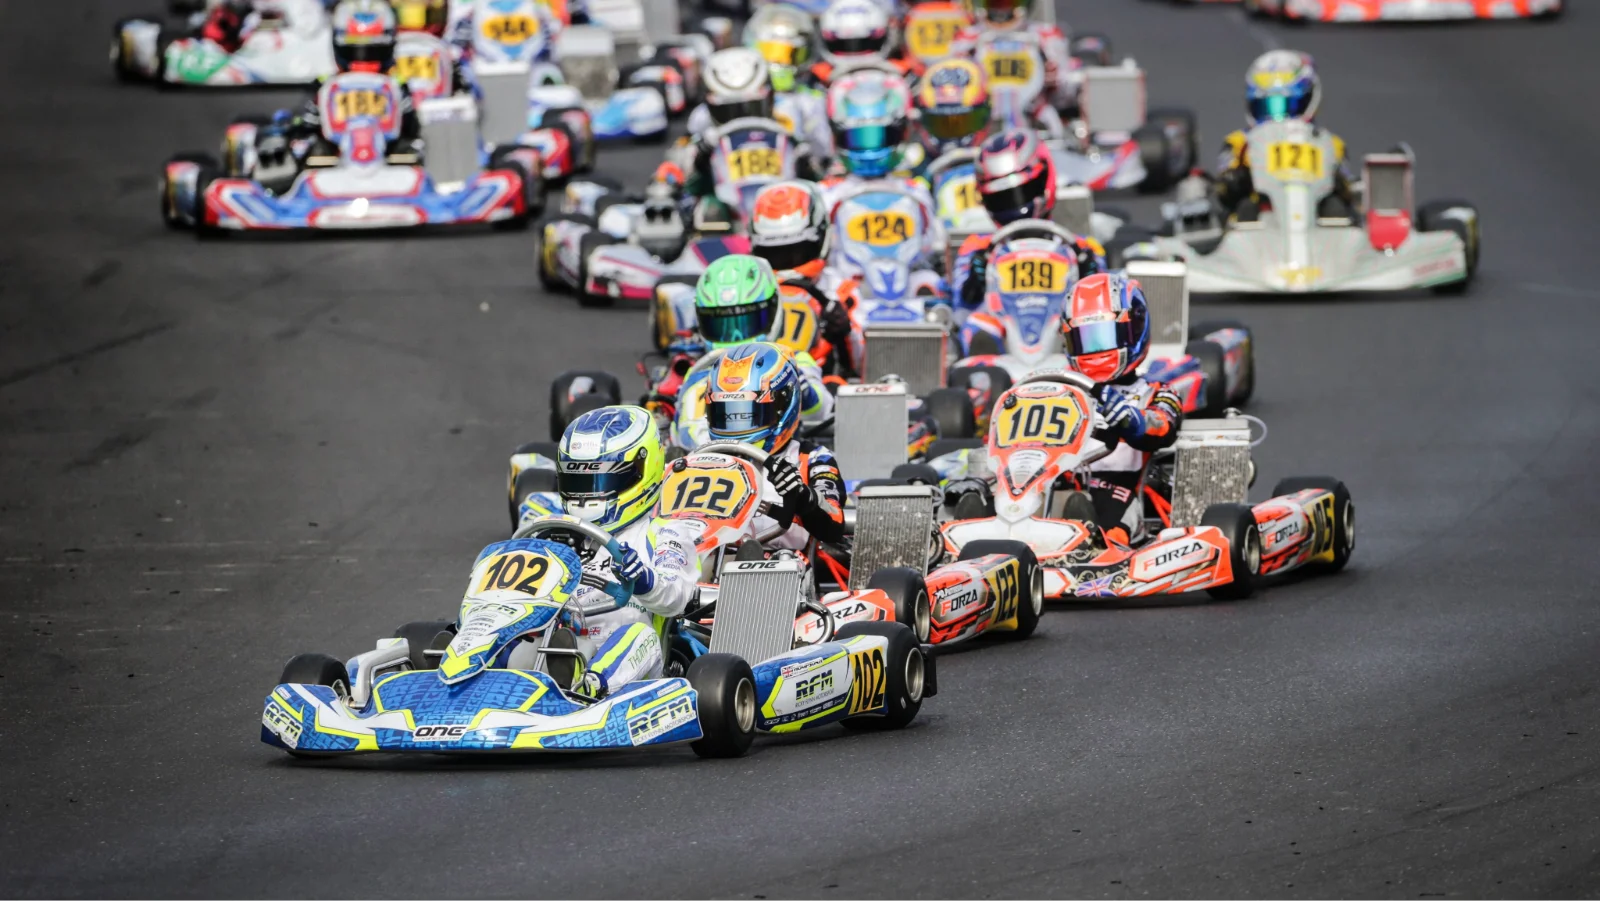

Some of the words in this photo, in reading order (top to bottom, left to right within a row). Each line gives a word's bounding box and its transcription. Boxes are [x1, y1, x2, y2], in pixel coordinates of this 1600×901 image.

[1275, 145, 1318, 168] 121
[858, 215, 908, 242] 124
[1008, 261, 1053, 289] 139
[1008, 404, 1070, 441] 105
[690, 456, 726, 464] FORZA
[671, 476, 735, 513] 122
[1143, 541, 1203, 571] FORZA
[483, 554, 549, 597] 102
[940, 588, 978, 617] FORZA
[994, 564, 1016, 625] 122
[795, 668, 833, 701] RFM
[853, 648, 885, 713] 102
[629, 697, 690, 738] RFM
